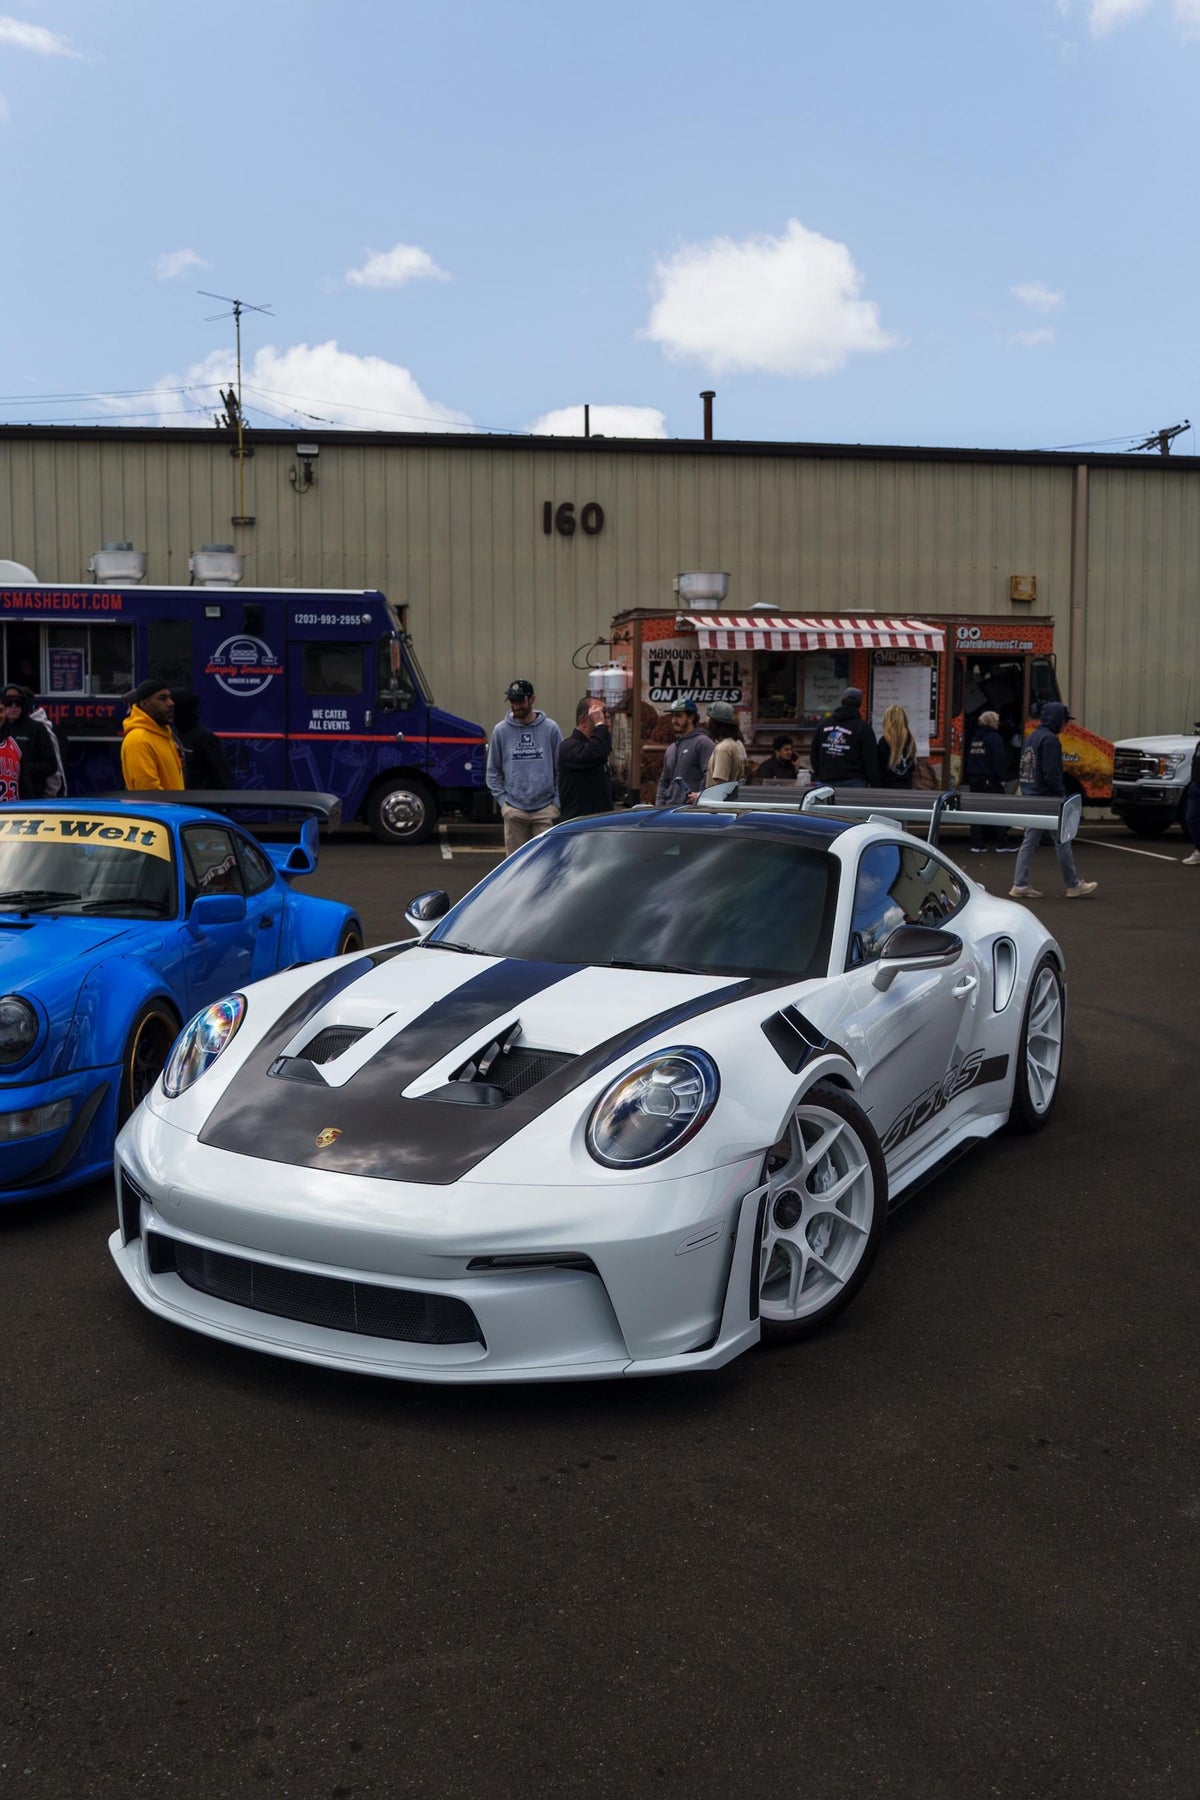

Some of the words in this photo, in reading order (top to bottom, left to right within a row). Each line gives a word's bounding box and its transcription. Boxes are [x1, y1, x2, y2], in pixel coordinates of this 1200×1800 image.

[544, 501, 604, 536] 160
[294, 614, 361, 625] (203)-993-2955
[649, 660, 742, 687] FALAFEL
[650, 689, 673, 701] ON
[677, 689, 739, 701] WHEELS
[312, 709, 323, 719] WE
[324, 709, 347, 720] CATER
[309, 720, 322, 730] ALL
[323, 720, 350, 731] EVENTS
